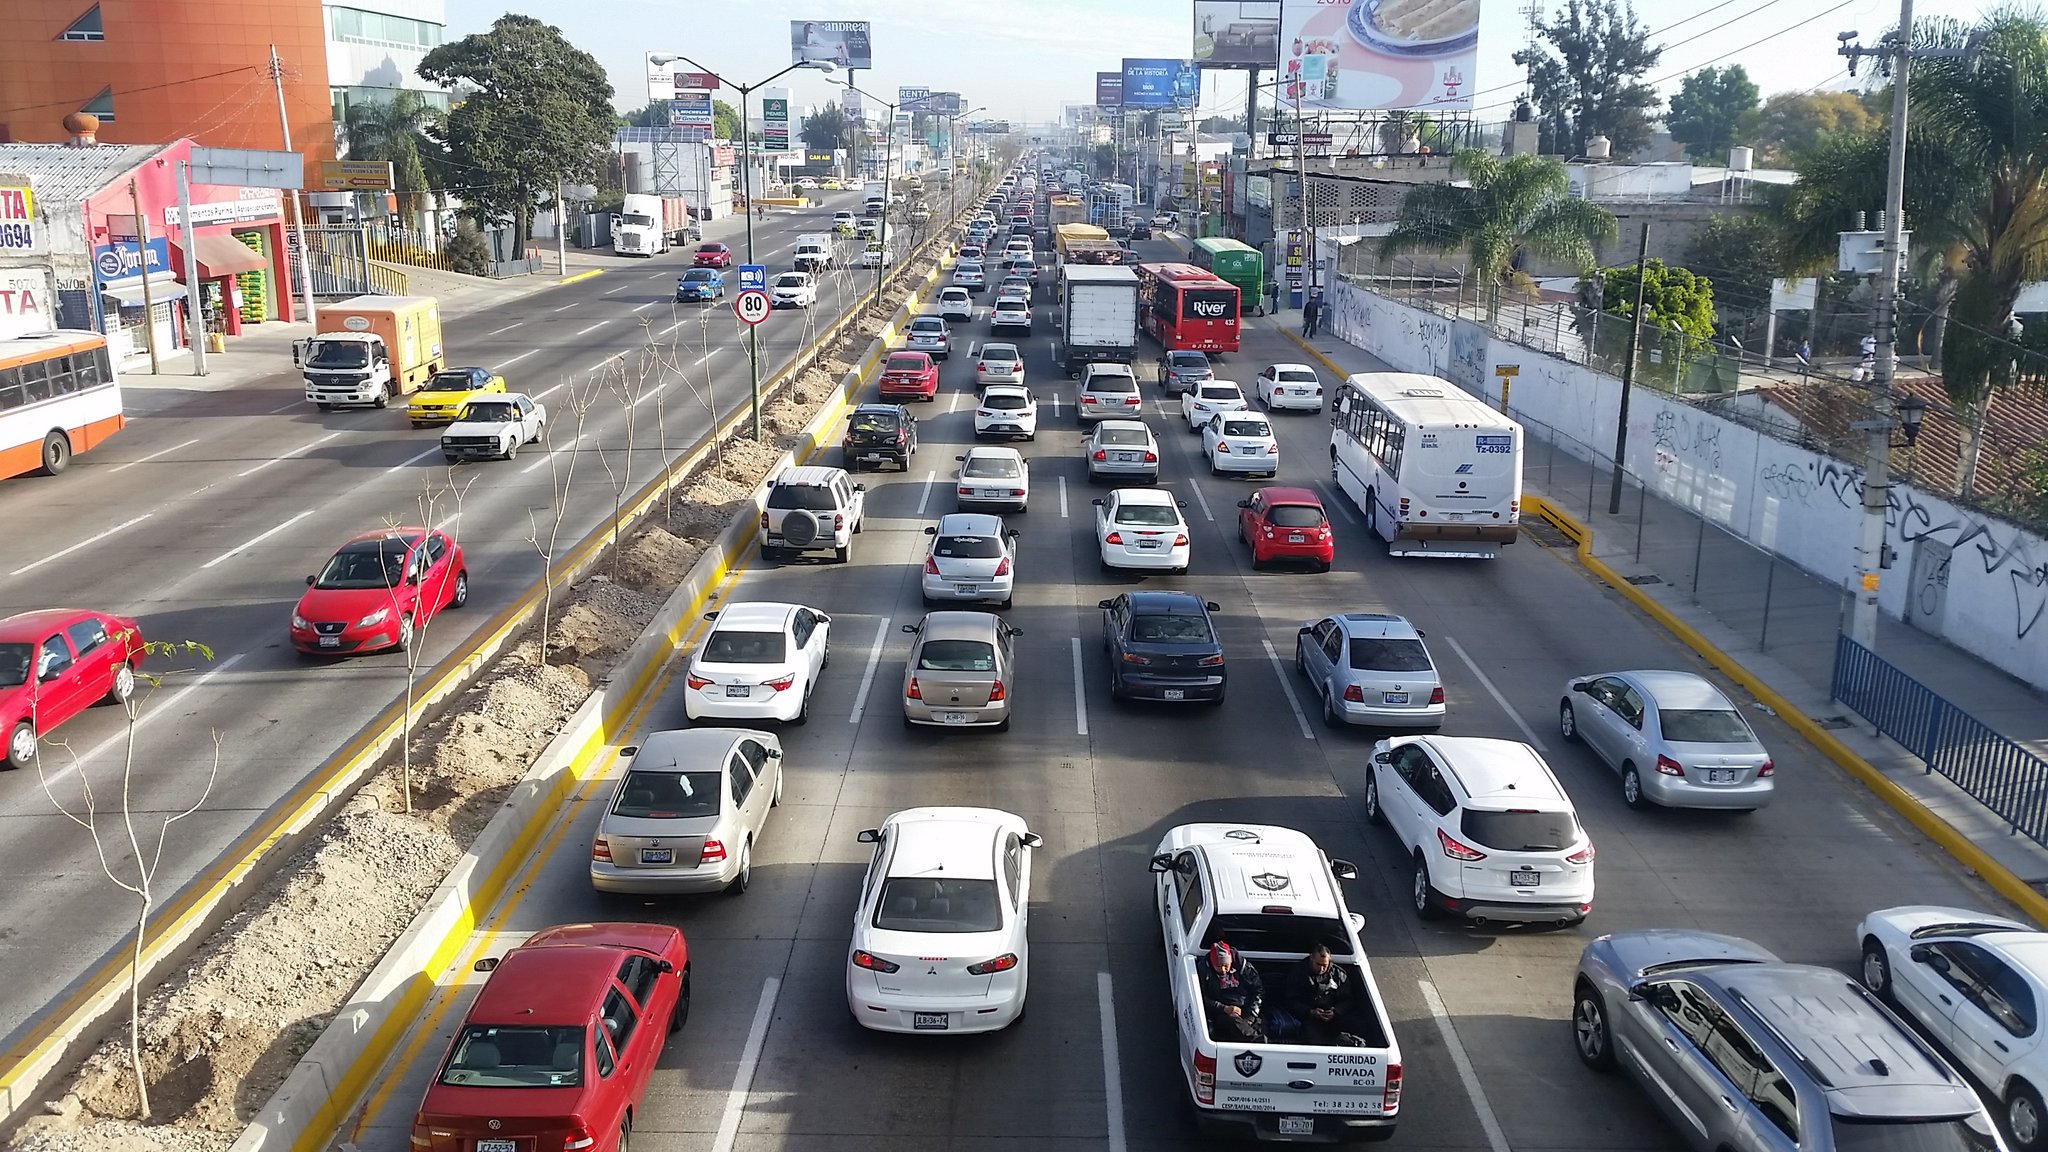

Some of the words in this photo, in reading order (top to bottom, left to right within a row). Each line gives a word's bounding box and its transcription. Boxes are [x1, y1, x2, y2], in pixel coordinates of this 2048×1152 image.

[900, 90, 929, 98] RENTA
[0, 190, 27, 219] TA
[115, 245, 161, 276] Corna
[9, 280, 37, 289] 5070
[745, 297, 762, 311] 80
[1193, 301, 1226, 316] River
[1476, 445, 1511, 454] Tz-0392
[1327, 1054, 1377, 1066] SEGURIDAD
[1328, 1068, 1375, 1078] PRIVADA
